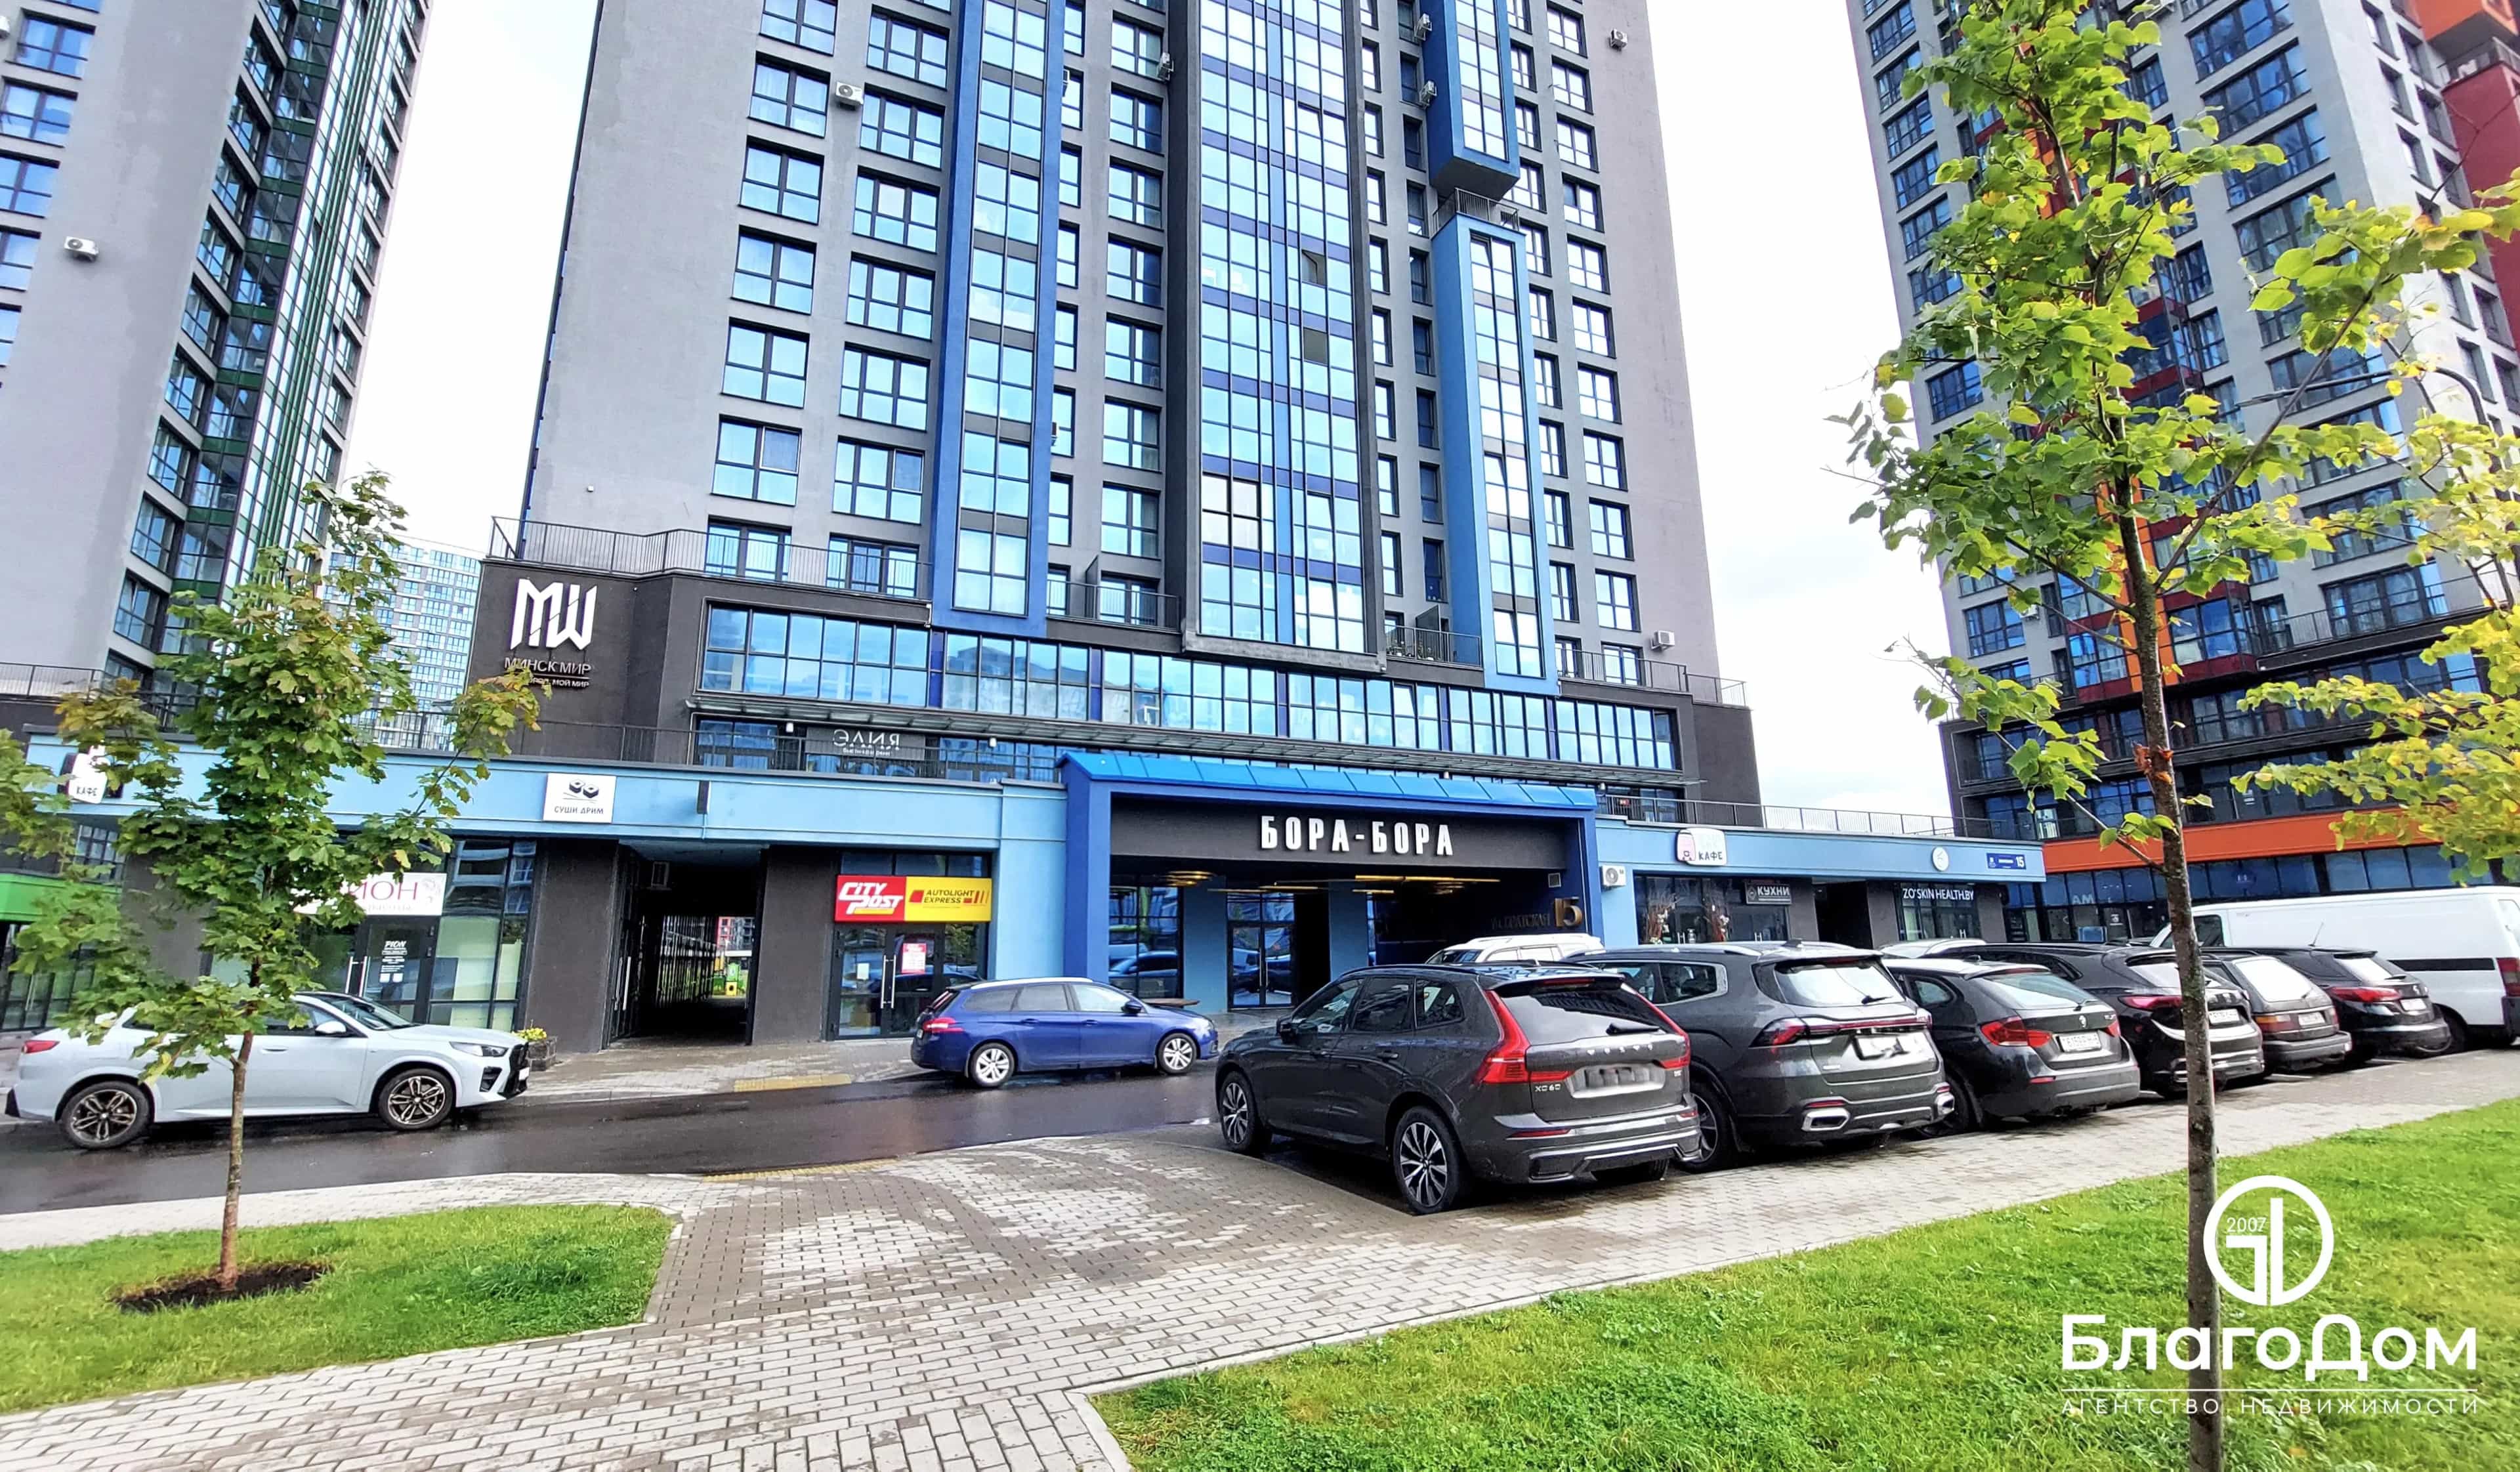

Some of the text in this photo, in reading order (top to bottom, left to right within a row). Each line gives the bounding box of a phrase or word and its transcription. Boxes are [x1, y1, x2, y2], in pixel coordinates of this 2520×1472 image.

[560, 662, 591, 675] МИР
[833, 729, 900, 750] ЭЛИЯ
[1261, 816, 1453, 856] БОРА-БОРА
[1698, 851, 1723, 861] КАФЕ
[2015, 856, 2025, 868] 15
[1757, 886, 1790, 895] КУХНИ
[1917, 888, 1935, 899] SKIN
[846, 894, 904, 914] POST
[1554, 896, 1582, 927] 15
